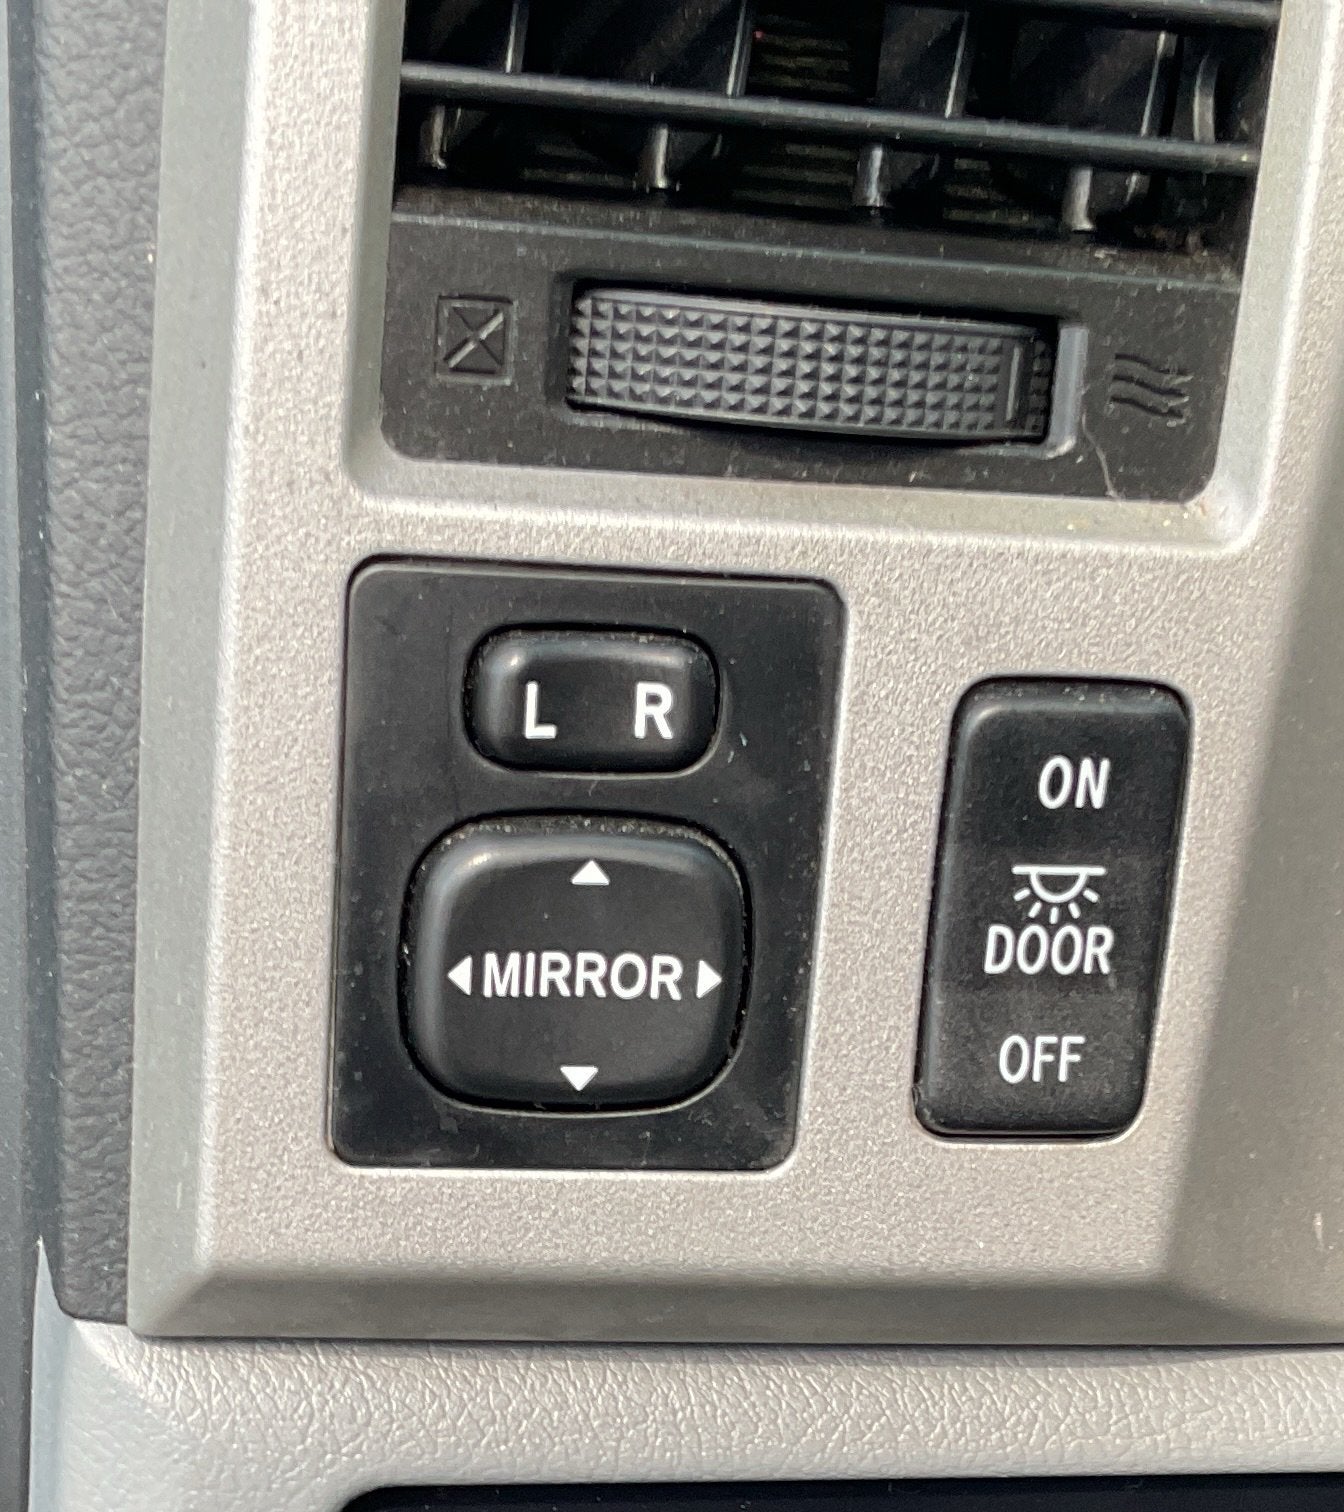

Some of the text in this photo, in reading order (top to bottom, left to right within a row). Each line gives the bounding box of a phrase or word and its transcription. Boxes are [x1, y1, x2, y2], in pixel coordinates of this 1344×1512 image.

[523, 681, 674, 740] L R
[1038, 755, 1111, 810] ON
[482, 951, 684, 1000] MIRROR
[983, 924, 1114, 976] DOOR
[998, 1033, 1086, 1084] OFF
